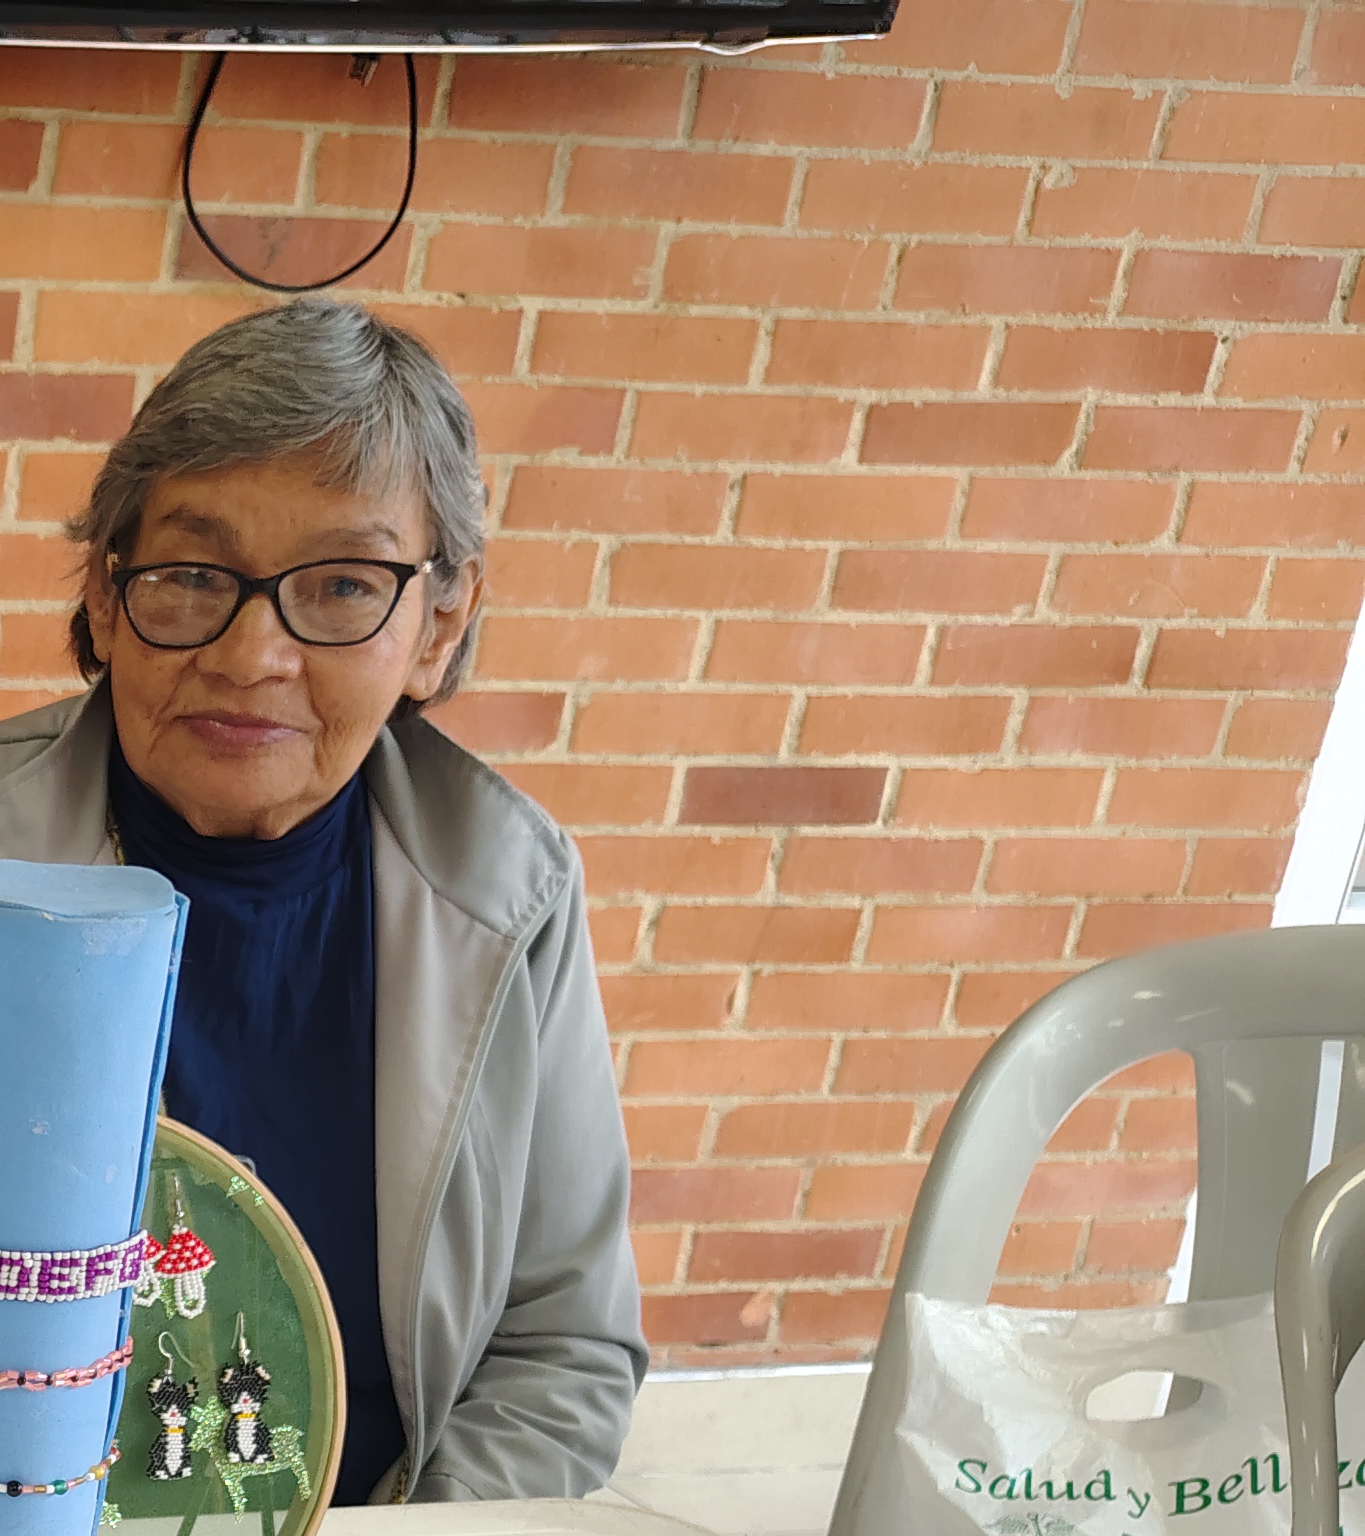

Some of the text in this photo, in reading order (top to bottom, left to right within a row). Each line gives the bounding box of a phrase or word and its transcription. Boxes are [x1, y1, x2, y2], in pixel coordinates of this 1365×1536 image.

[955, 1452, 1365, 1518] Salud y Bellz
